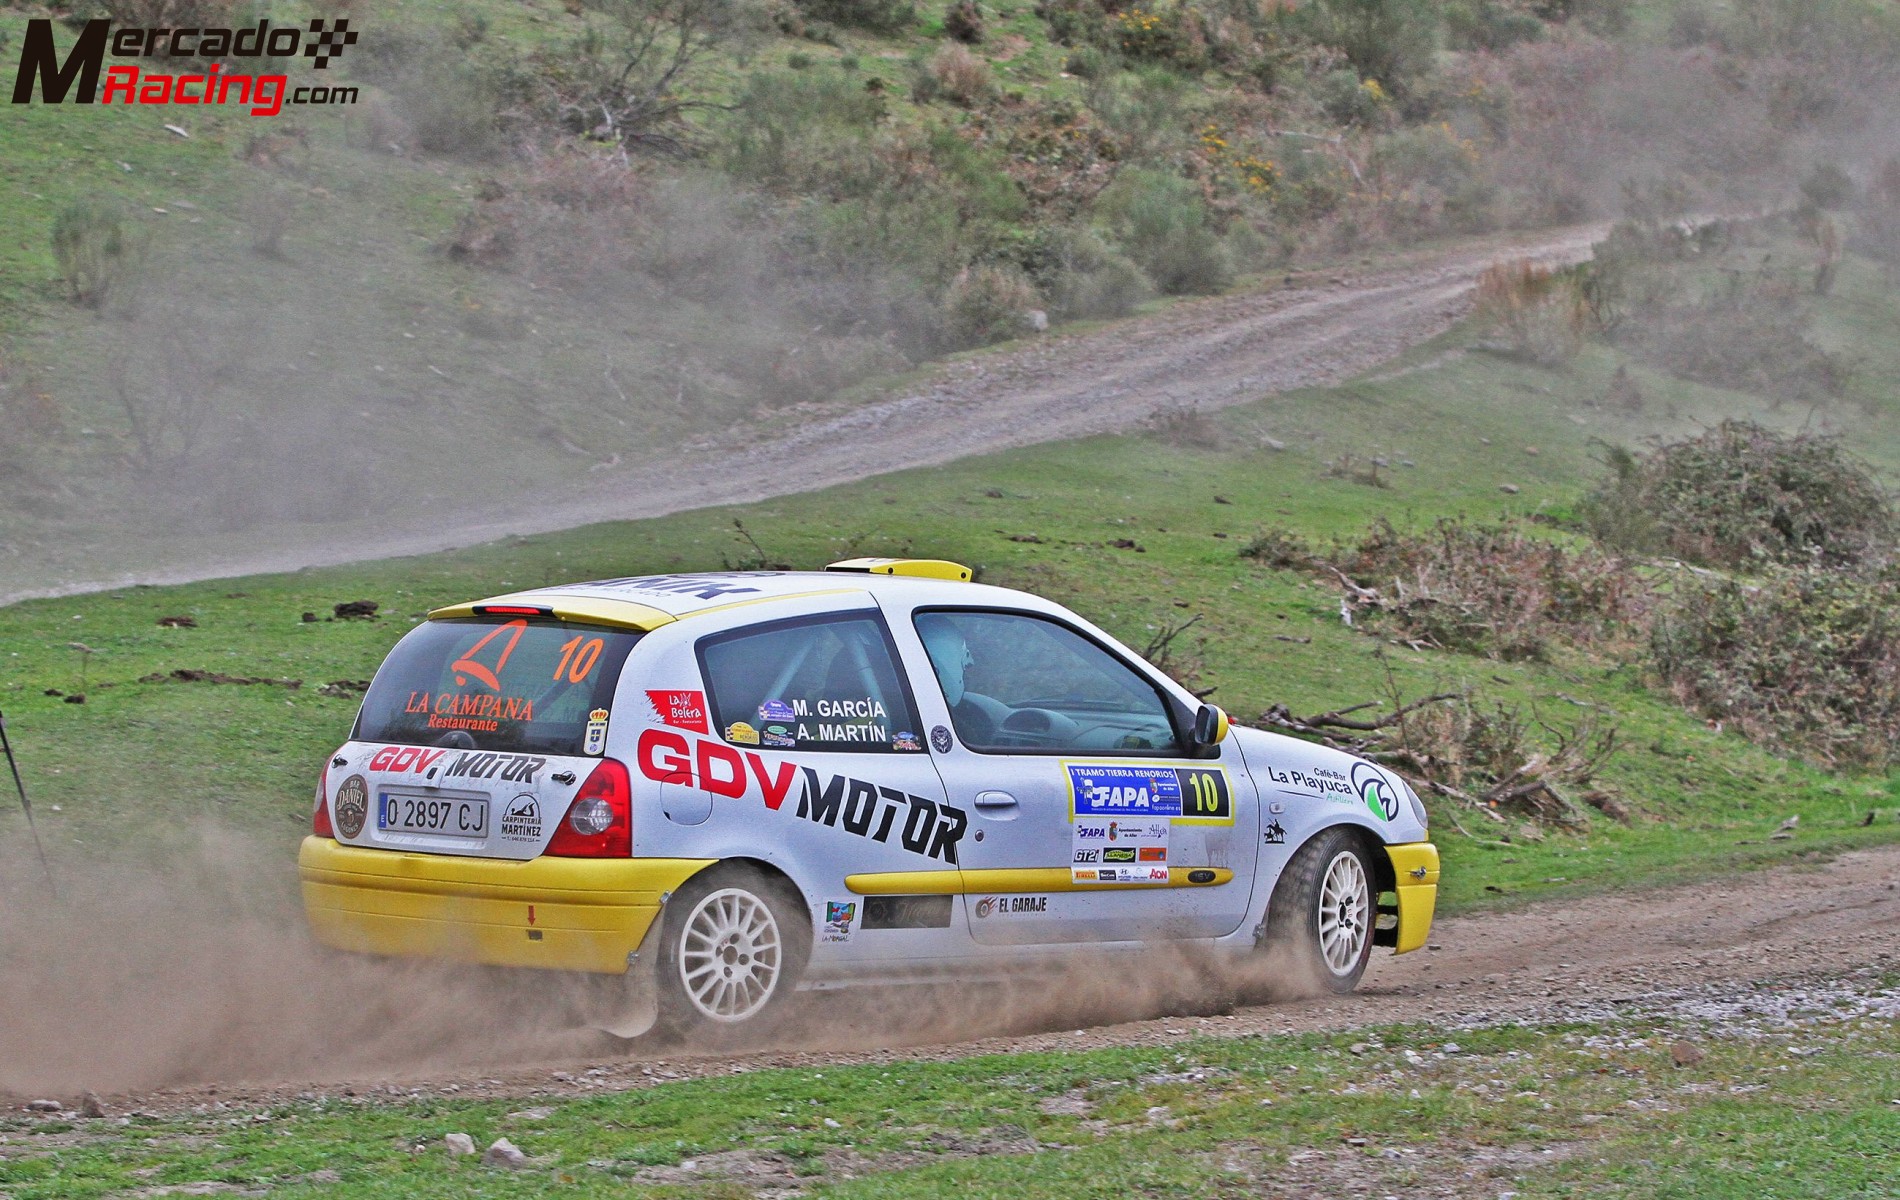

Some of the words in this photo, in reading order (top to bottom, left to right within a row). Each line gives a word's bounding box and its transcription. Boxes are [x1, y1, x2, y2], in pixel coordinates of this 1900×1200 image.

[552, 635, 604, 684] 10
[405, 691, 429, 713] LA
[434, 693, 533, 721] CAMPANA
[669, 694, 680, 705] La
[793, 699, 812, 716] M.
[817, 697, 887, 718] GARCÍA
[428, 713, 498, 731] Restaurante
[797, 723, 815, 740] A.
[819, 721, 886, 742] MARTÍN
[369, 746, 446, 774] GDV
[445, 752, 546, 784] MOTOR
[1075, 769, 1105, 777] TRAMO
[1105, 769, 1134, 777] TIERRA
[1135, 770, 1174, 779] RENORIOS
[1314, 767, 1346, 781] Café-Bar
[1267, 766, 1289, 784] La
[1290, 770, 1353, 795] Playuca
[337, 788, 365, 812] DANIEL
[637, 728, 797, 811] GDV
[796, 766, 967, 865] MOTOR
[1092, 786, 1150, 808] FAPA
[1189, 772, 1218, 811] 10
[404, 799, 452, 829] 2897
[458, 803, 484, 831] CJ
[1080, 828, 1105, 838] FAPA
[1074, 849, 1100, 862] GT2i
[999, 898, 1009, 912] EL
[1012, 897, 1047, 912] GARAJE
